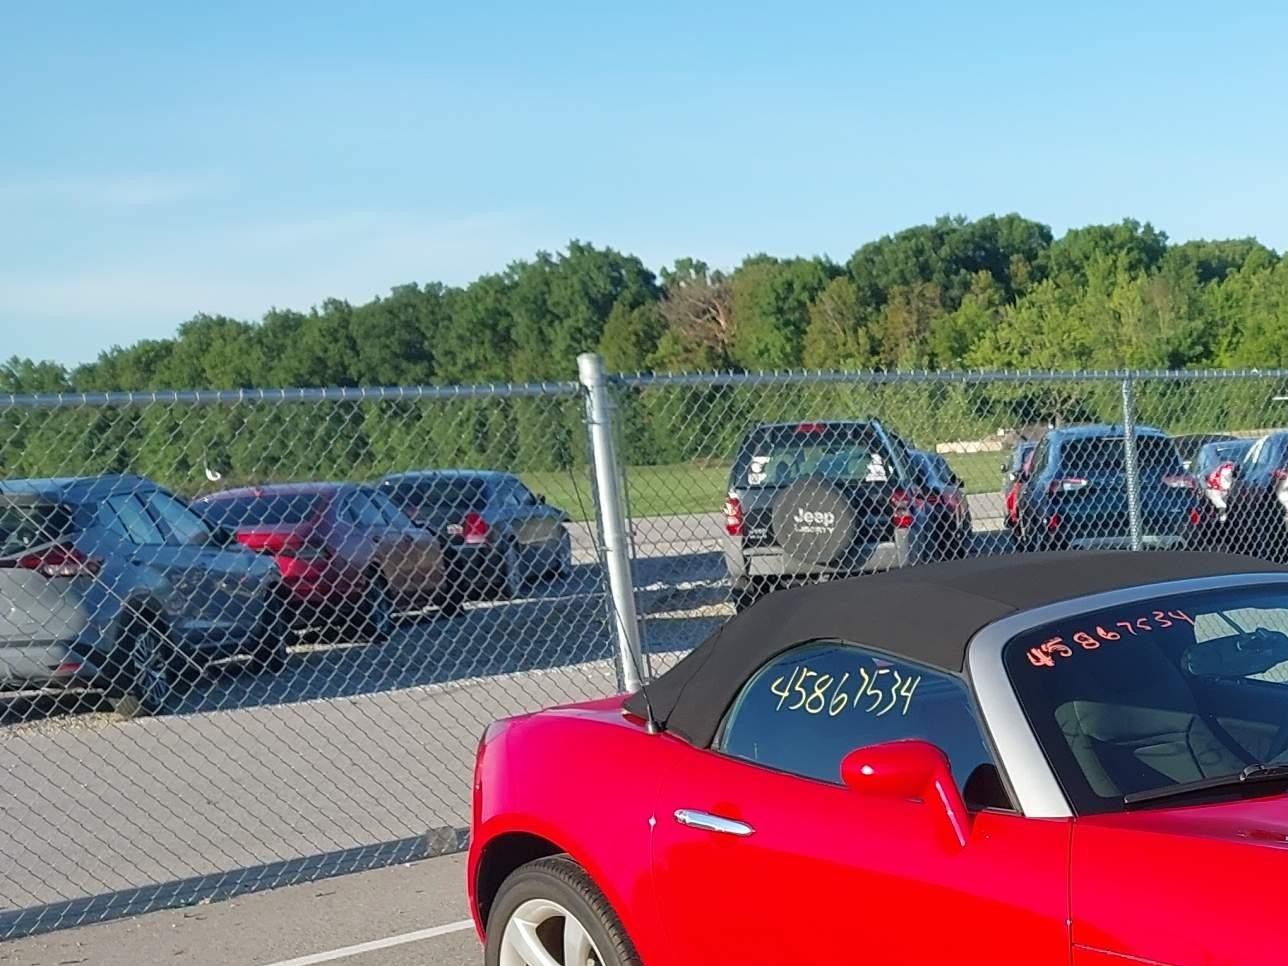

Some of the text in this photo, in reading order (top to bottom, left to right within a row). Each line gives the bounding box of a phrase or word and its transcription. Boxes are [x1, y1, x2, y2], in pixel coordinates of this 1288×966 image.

[793, 507, 835, 527] Jeep
[1026, 609, 1197, 668] 45867534
[770, 665, 922, 717] 45867534
